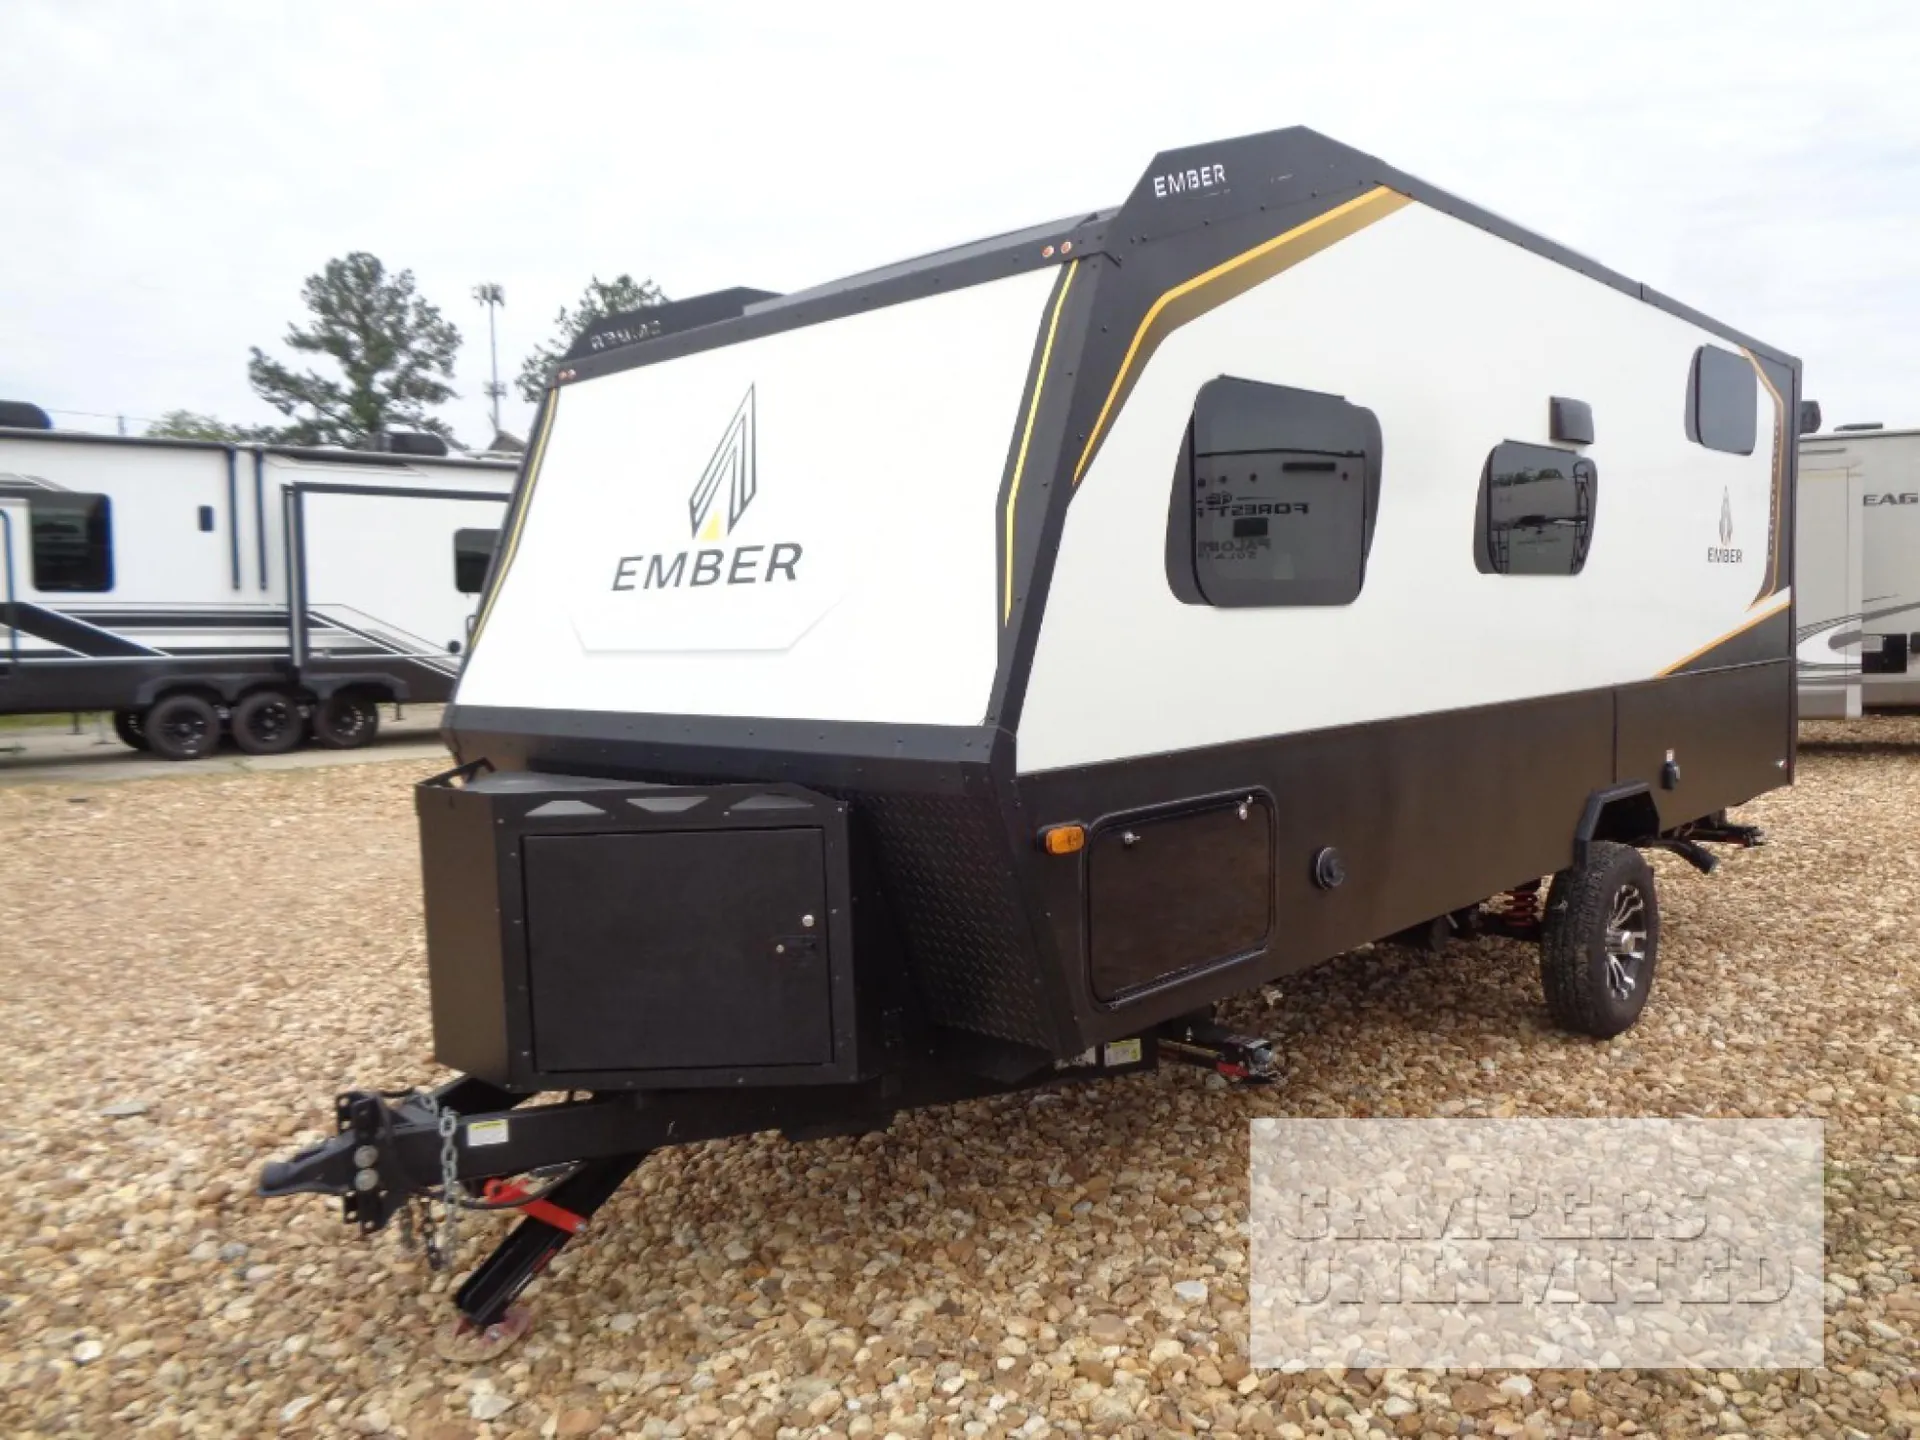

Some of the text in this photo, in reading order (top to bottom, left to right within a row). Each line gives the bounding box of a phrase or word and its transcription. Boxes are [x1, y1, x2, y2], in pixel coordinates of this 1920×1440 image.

[1153, 164, 1226, 198] EMBER
[611, 542, 803, 591] EMBER
[1707, 546, 1743, 563] EMBER
